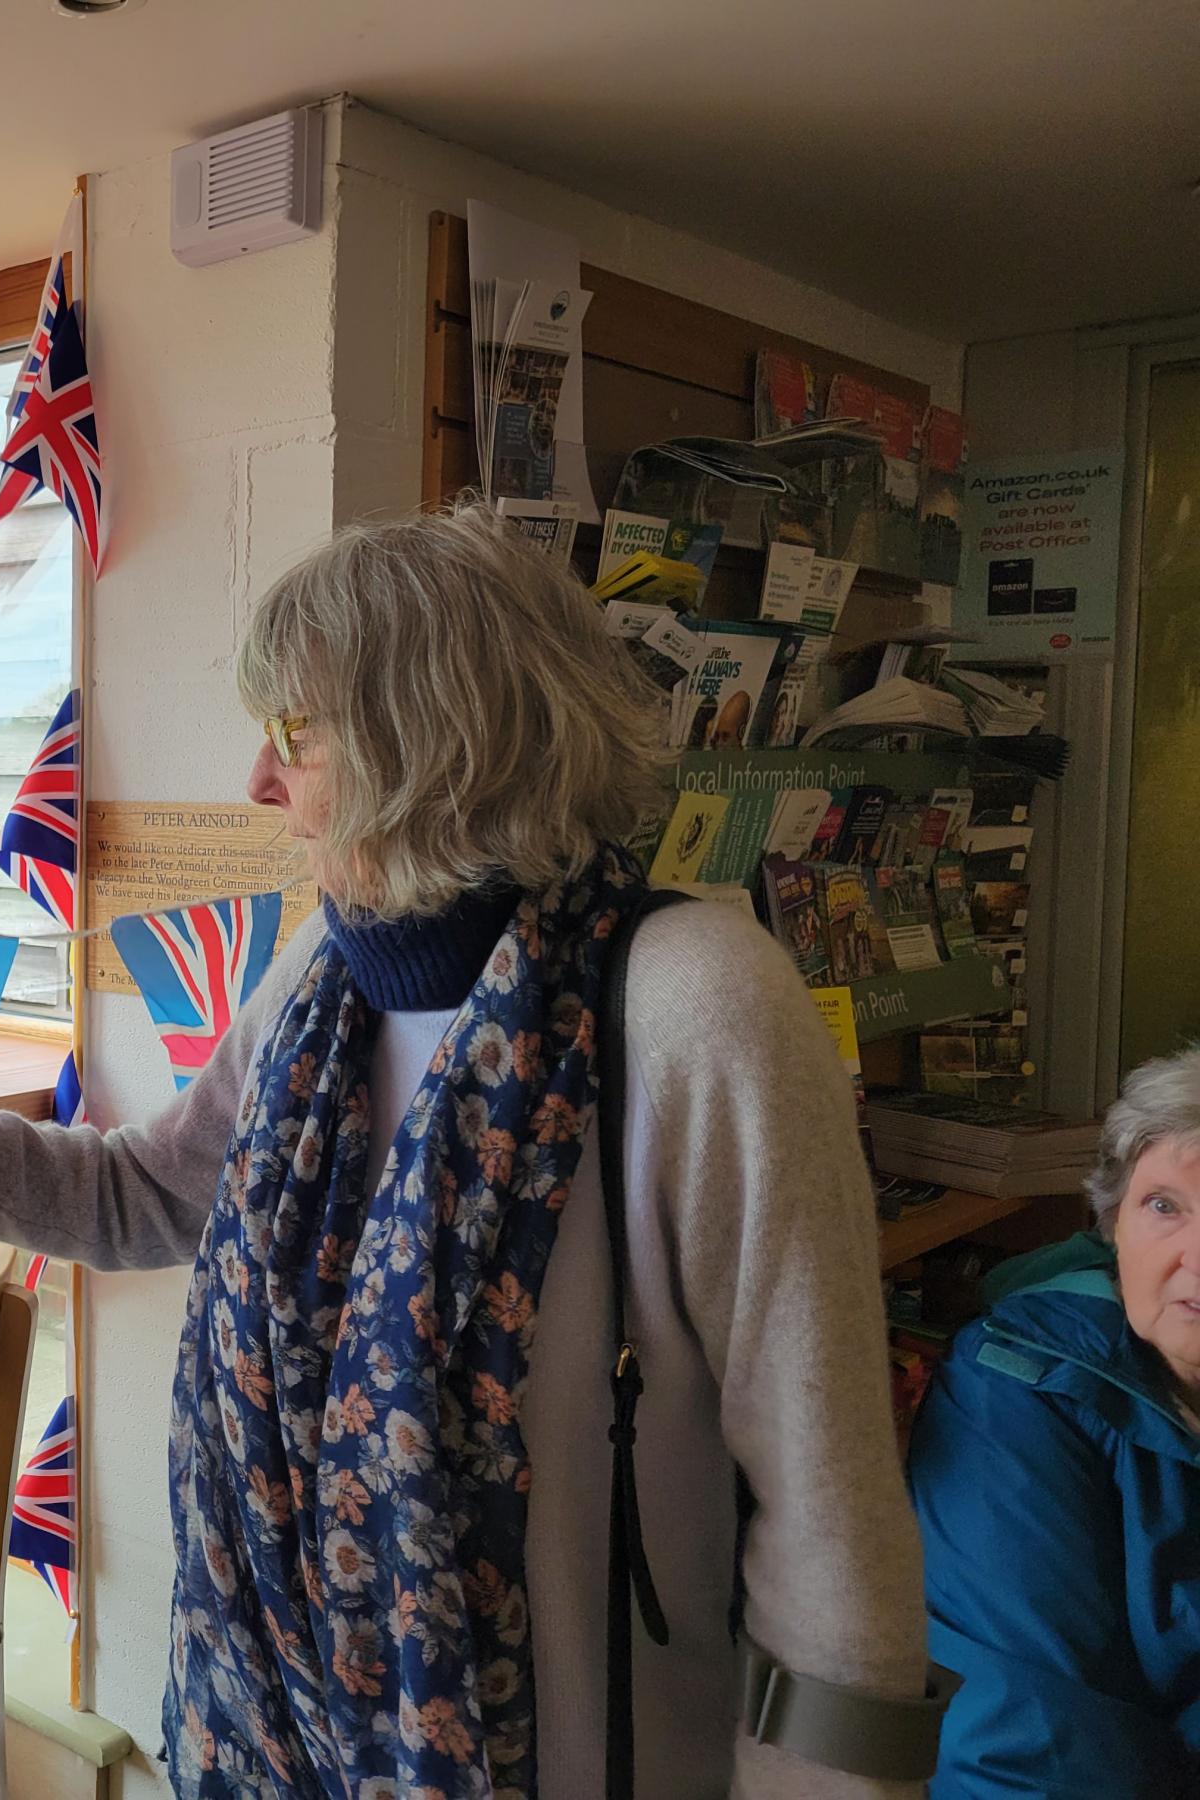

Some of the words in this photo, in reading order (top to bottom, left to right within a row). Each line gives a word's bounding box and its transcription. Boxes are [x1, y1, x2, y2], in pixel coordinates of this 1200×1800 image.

[969, 465, 1110, 490] Amazon.co.uk
[986, 490, 1022, 504] Gift
[998, 507, 1028, 519] are
[1034, 502, 1076, 515] now
[534, 522, 556, 538] THESE
[615, 522, 666, 544] AFFECTED
[983, 519, 1066, 536] available
[1071, 518, 1091, 528] at
[611, 541, 622, 554] BY
[979, 540, 1024, 552] Post
[1028, 535, 1091, 549] Office
[992, 582, 1028, 592] amazon
[700, 660, 742, 678] ALWAYS
[696, 678, 722, 696] HERE
[676, 762, 722, 794] Local
[728, 760, 824, 790] Information
[829, 762, 866, 789] Point
[144, 812, 185, 826] PETER
[189, 813, 249, 828] ARNOLD
[98, 840, 112, 852] We
[114, 842, 142, 854] would
[145, 842, 162, 854] like
[164, 845, 174, 854] to
[177, 844, 216, 857] dedicate
[219, 844, 236, 857] this
[103, 858, 112, 866] to
[114, 856, 128, 867] the
[132, 856, 148, 868] late
[150, 858, 174, 870] Peter
[176, 859, 214, 874] Arnold,
[216, 861, 238, 873] who
[241, 862, 272, 878] kindly
[97, 870, 124, 885] legacy
[127, 873, 136, 883] to
[139, 872, 153, 884] the
[156, 873, 210, 889] Woodgreen
[213, 876, 274, 891] Community
[96, 886, 110, 896] We
[113, 886, 132, 898] have
[134, 888, 154, 900] used
[158, 888, 170, 900] his
[110, 974, 126, 985] The
[823, 1000, 840, 1009] FAIR
[869, 988, 909, 1019] Point
